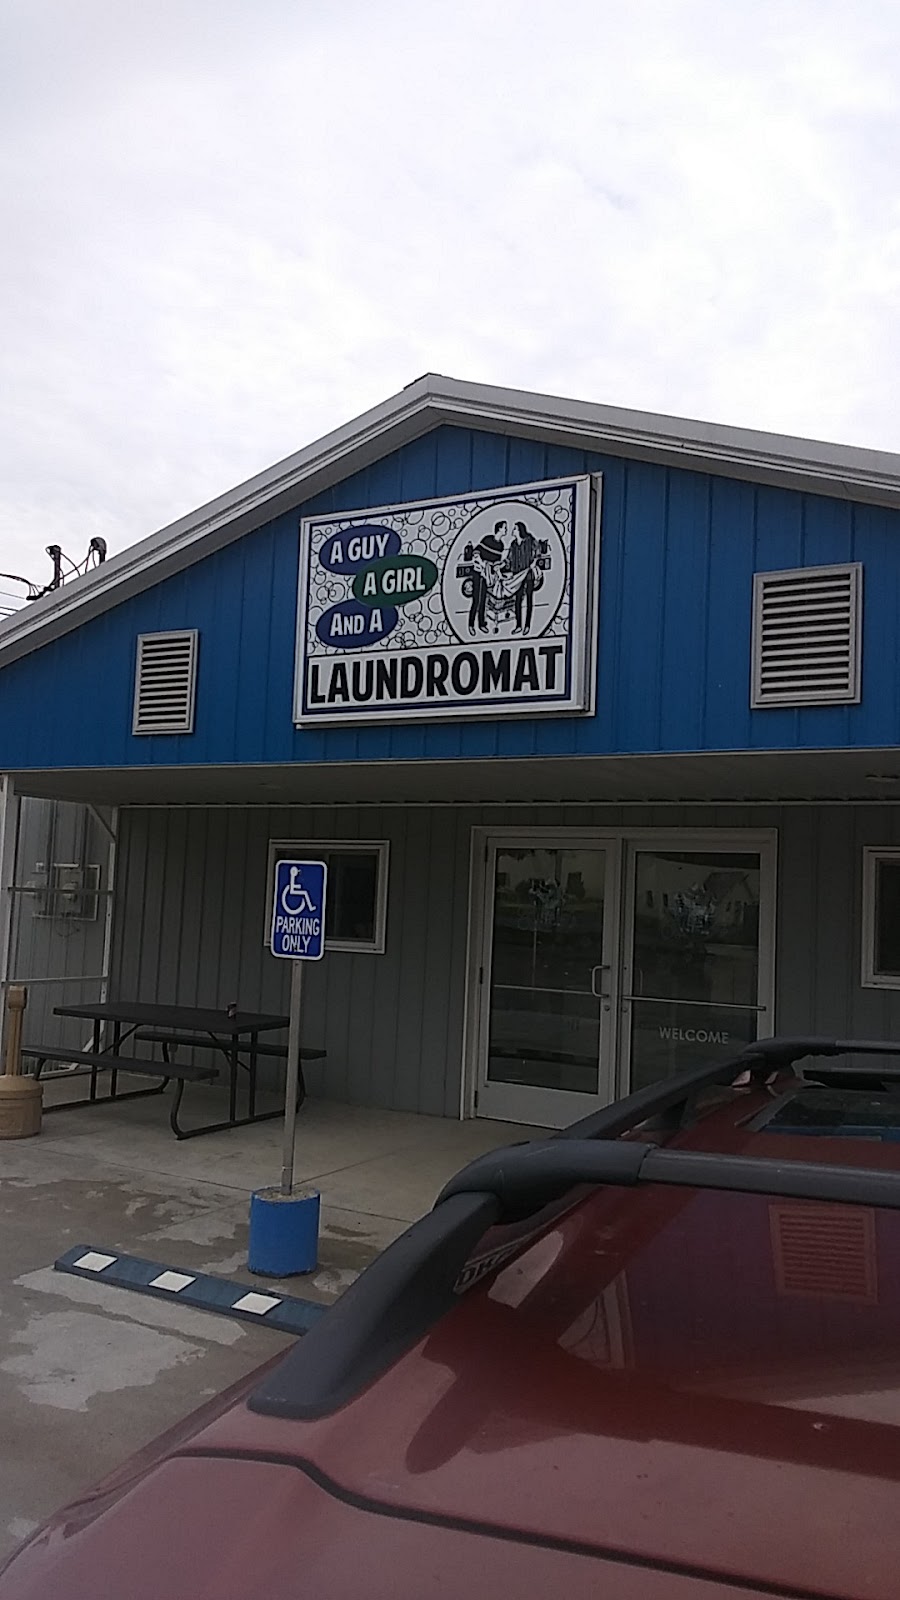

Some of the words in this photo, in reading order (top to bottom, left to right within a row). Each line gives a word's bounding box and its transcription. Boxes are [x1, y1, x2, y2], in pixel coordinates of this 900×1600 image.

[329, 540, 345, 564] A
[347, 533, 390, 561] GUY
[363, 572, 377, 596] A
[381, 566, 426, 593] GIRL
[330, 612, 364, 637] AND
[369, 609, 383, 633] A
[310, 645, 563, 703] LAUNDROMAT
[276, 916, 320, 936] PARKING
[282, 934, 311, 953] ONLY
[659, 1026, 729, 1044] WELCOME
